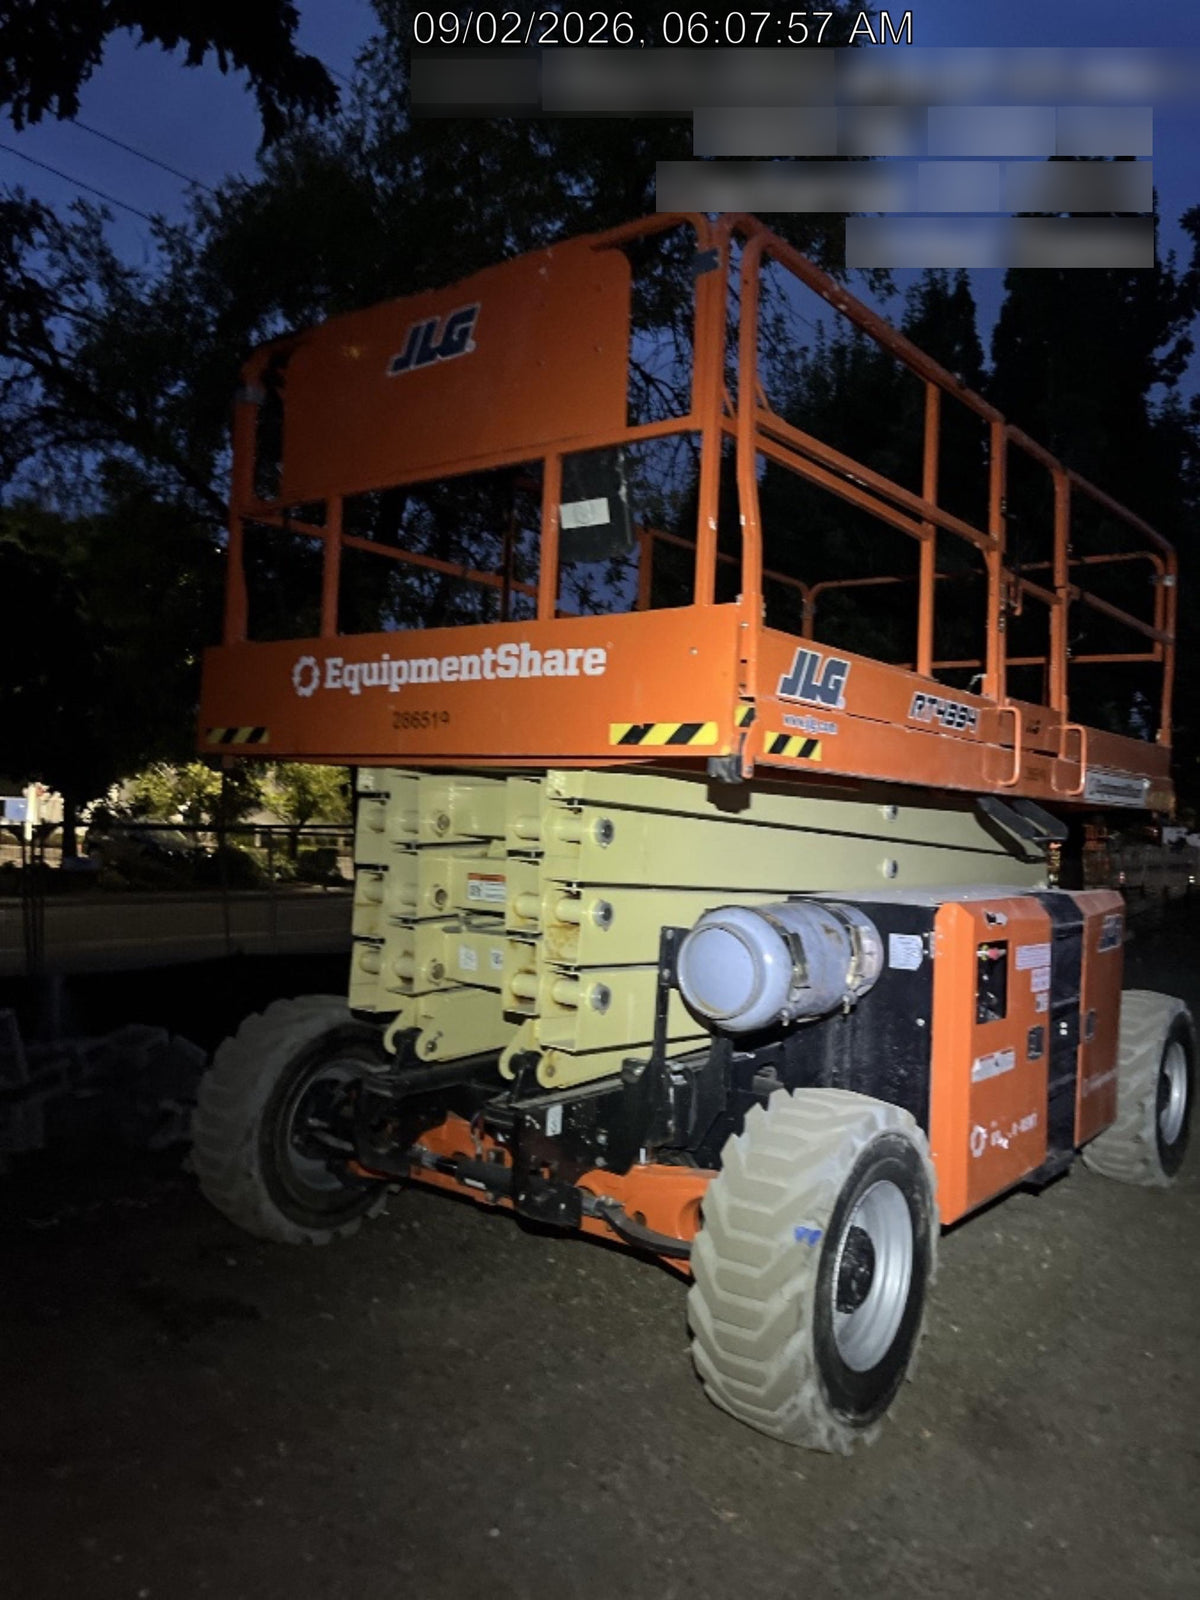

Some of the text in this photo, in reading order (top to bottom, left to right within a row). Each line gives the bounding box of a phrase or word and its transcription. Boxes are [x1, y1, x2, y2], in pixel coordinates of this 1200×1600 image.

[386, 303, 480, 377] JLG
[323, 641, 607, 695] EquipmentShare
[777, 647, 851, 709] JLG
